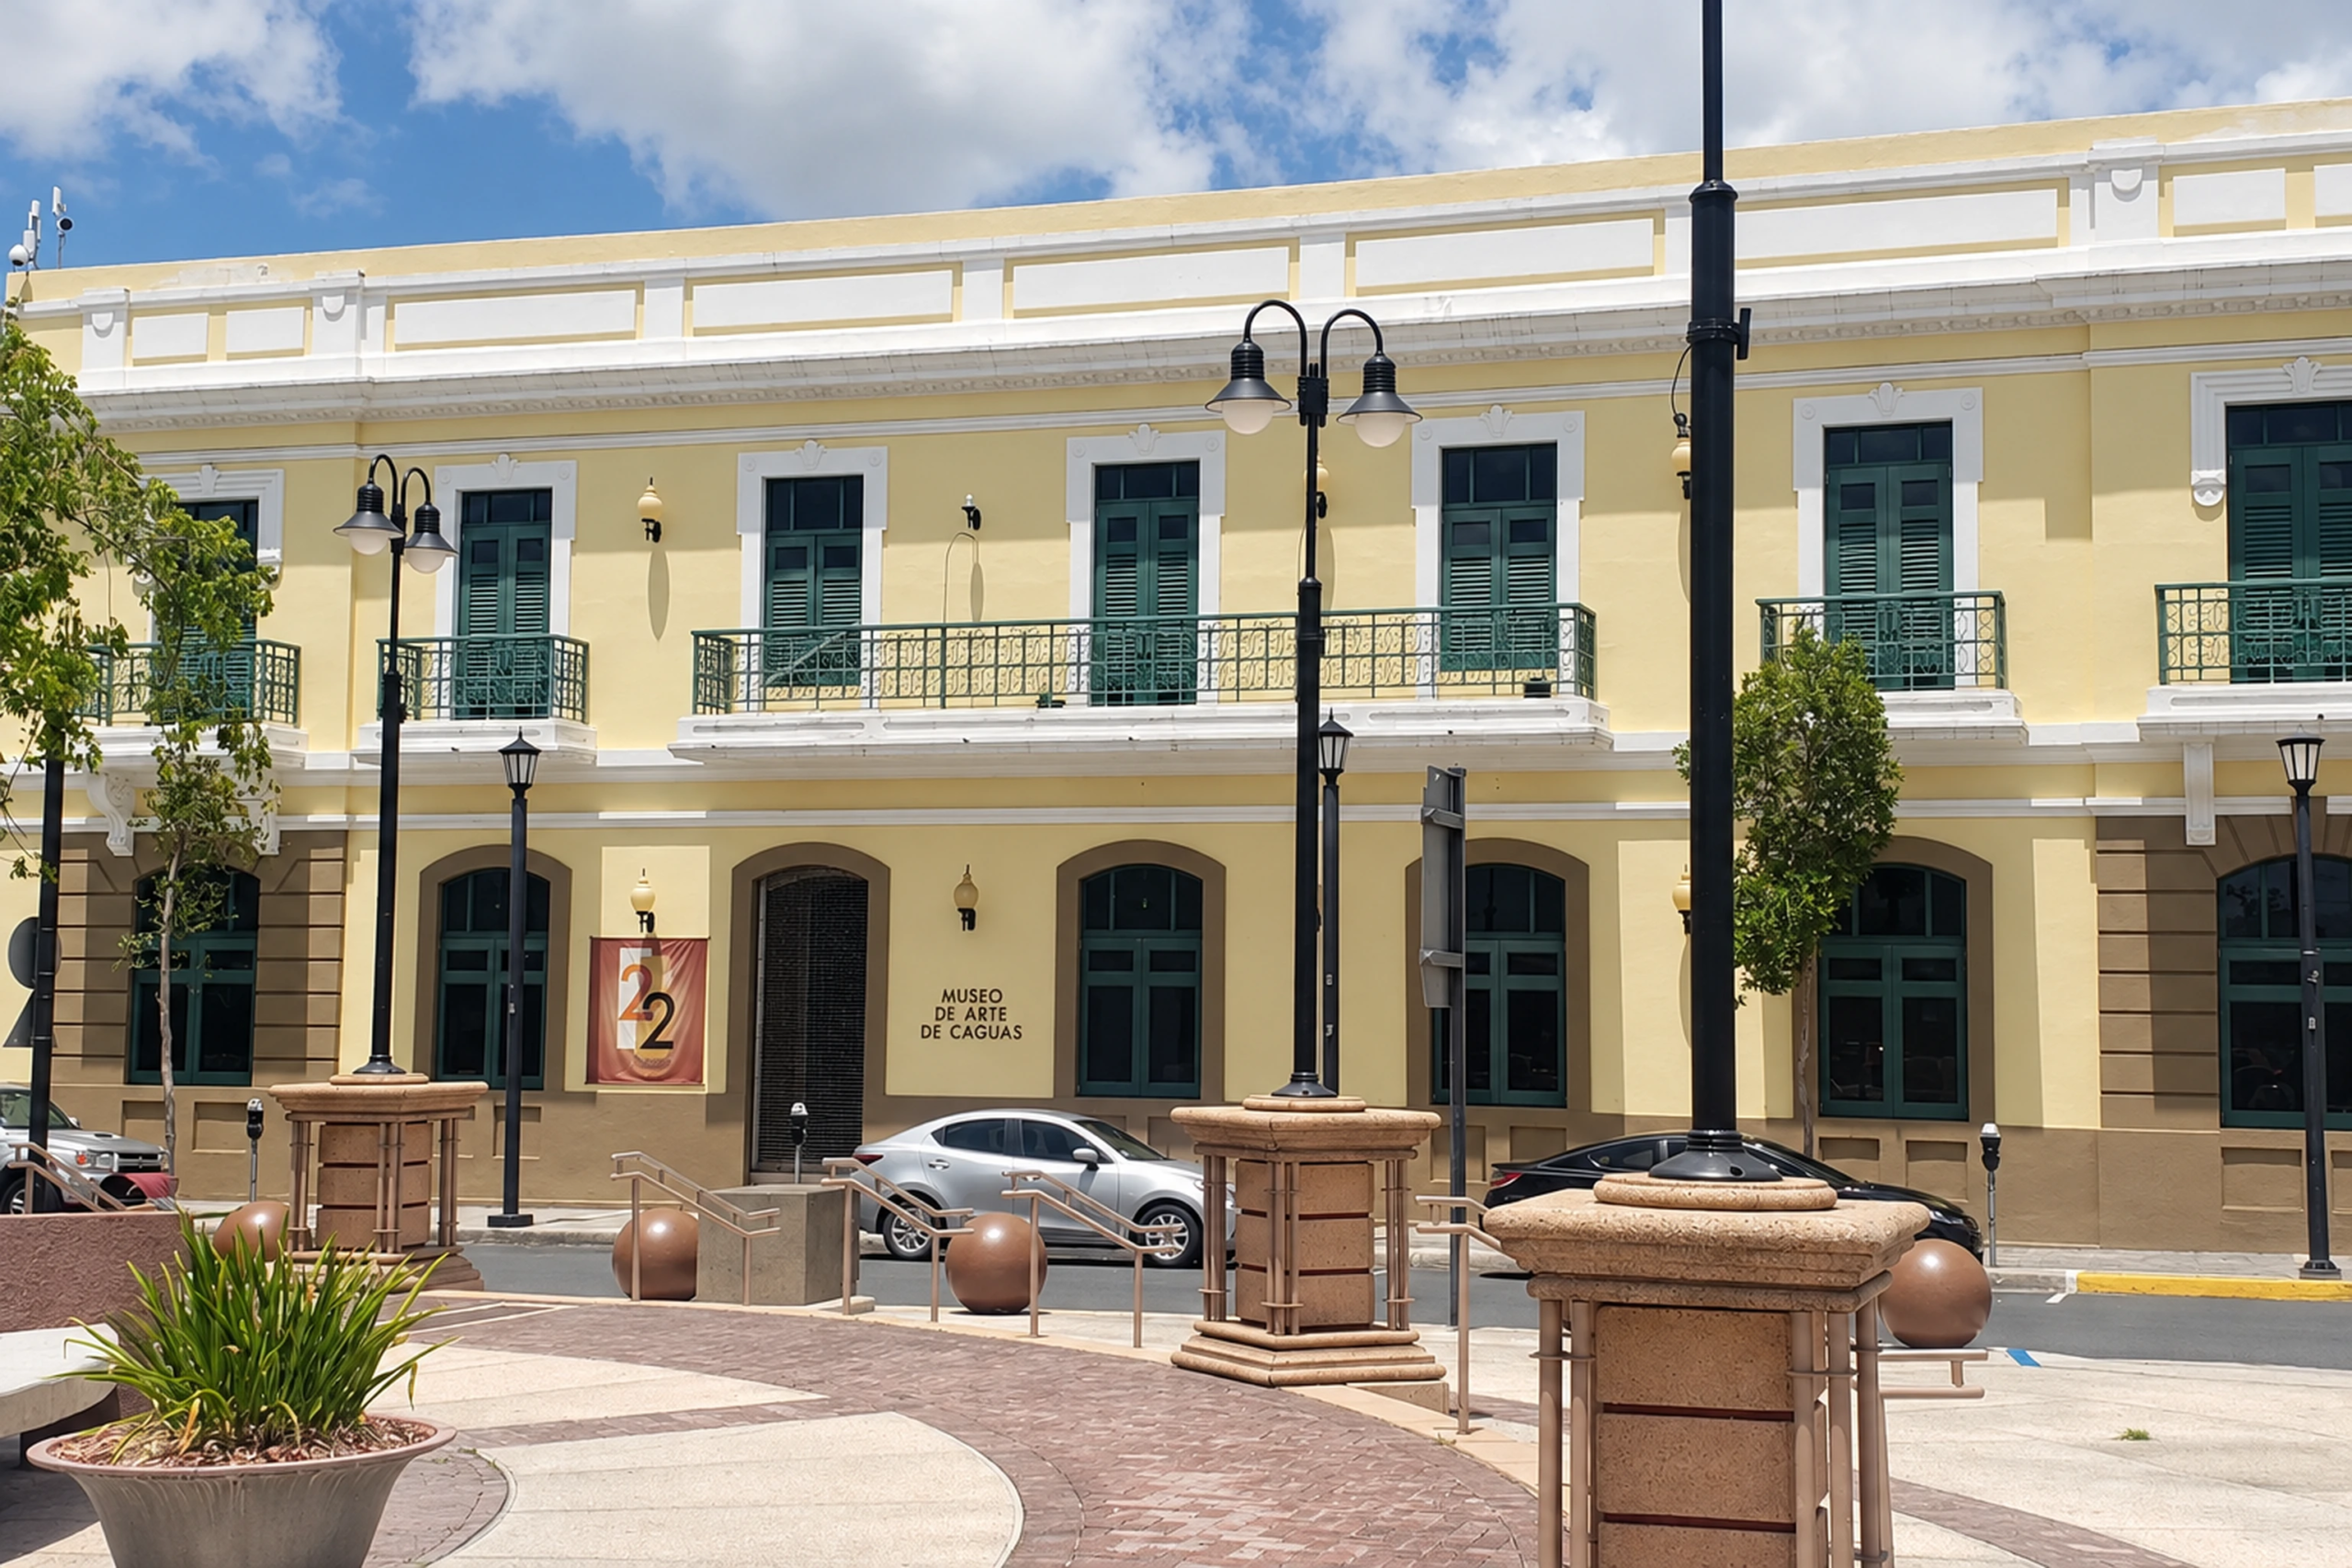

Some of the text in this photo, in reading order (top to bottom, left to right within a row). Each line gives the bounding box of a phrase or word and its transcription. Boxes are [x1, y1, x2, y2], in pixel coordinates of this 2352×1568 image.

[941, 988, 1003, 1004] MUSEO
[935, 1006, 1007, 1021] DE ARTE
[921, 1024, 1023, 1040] DE CAGUAS
